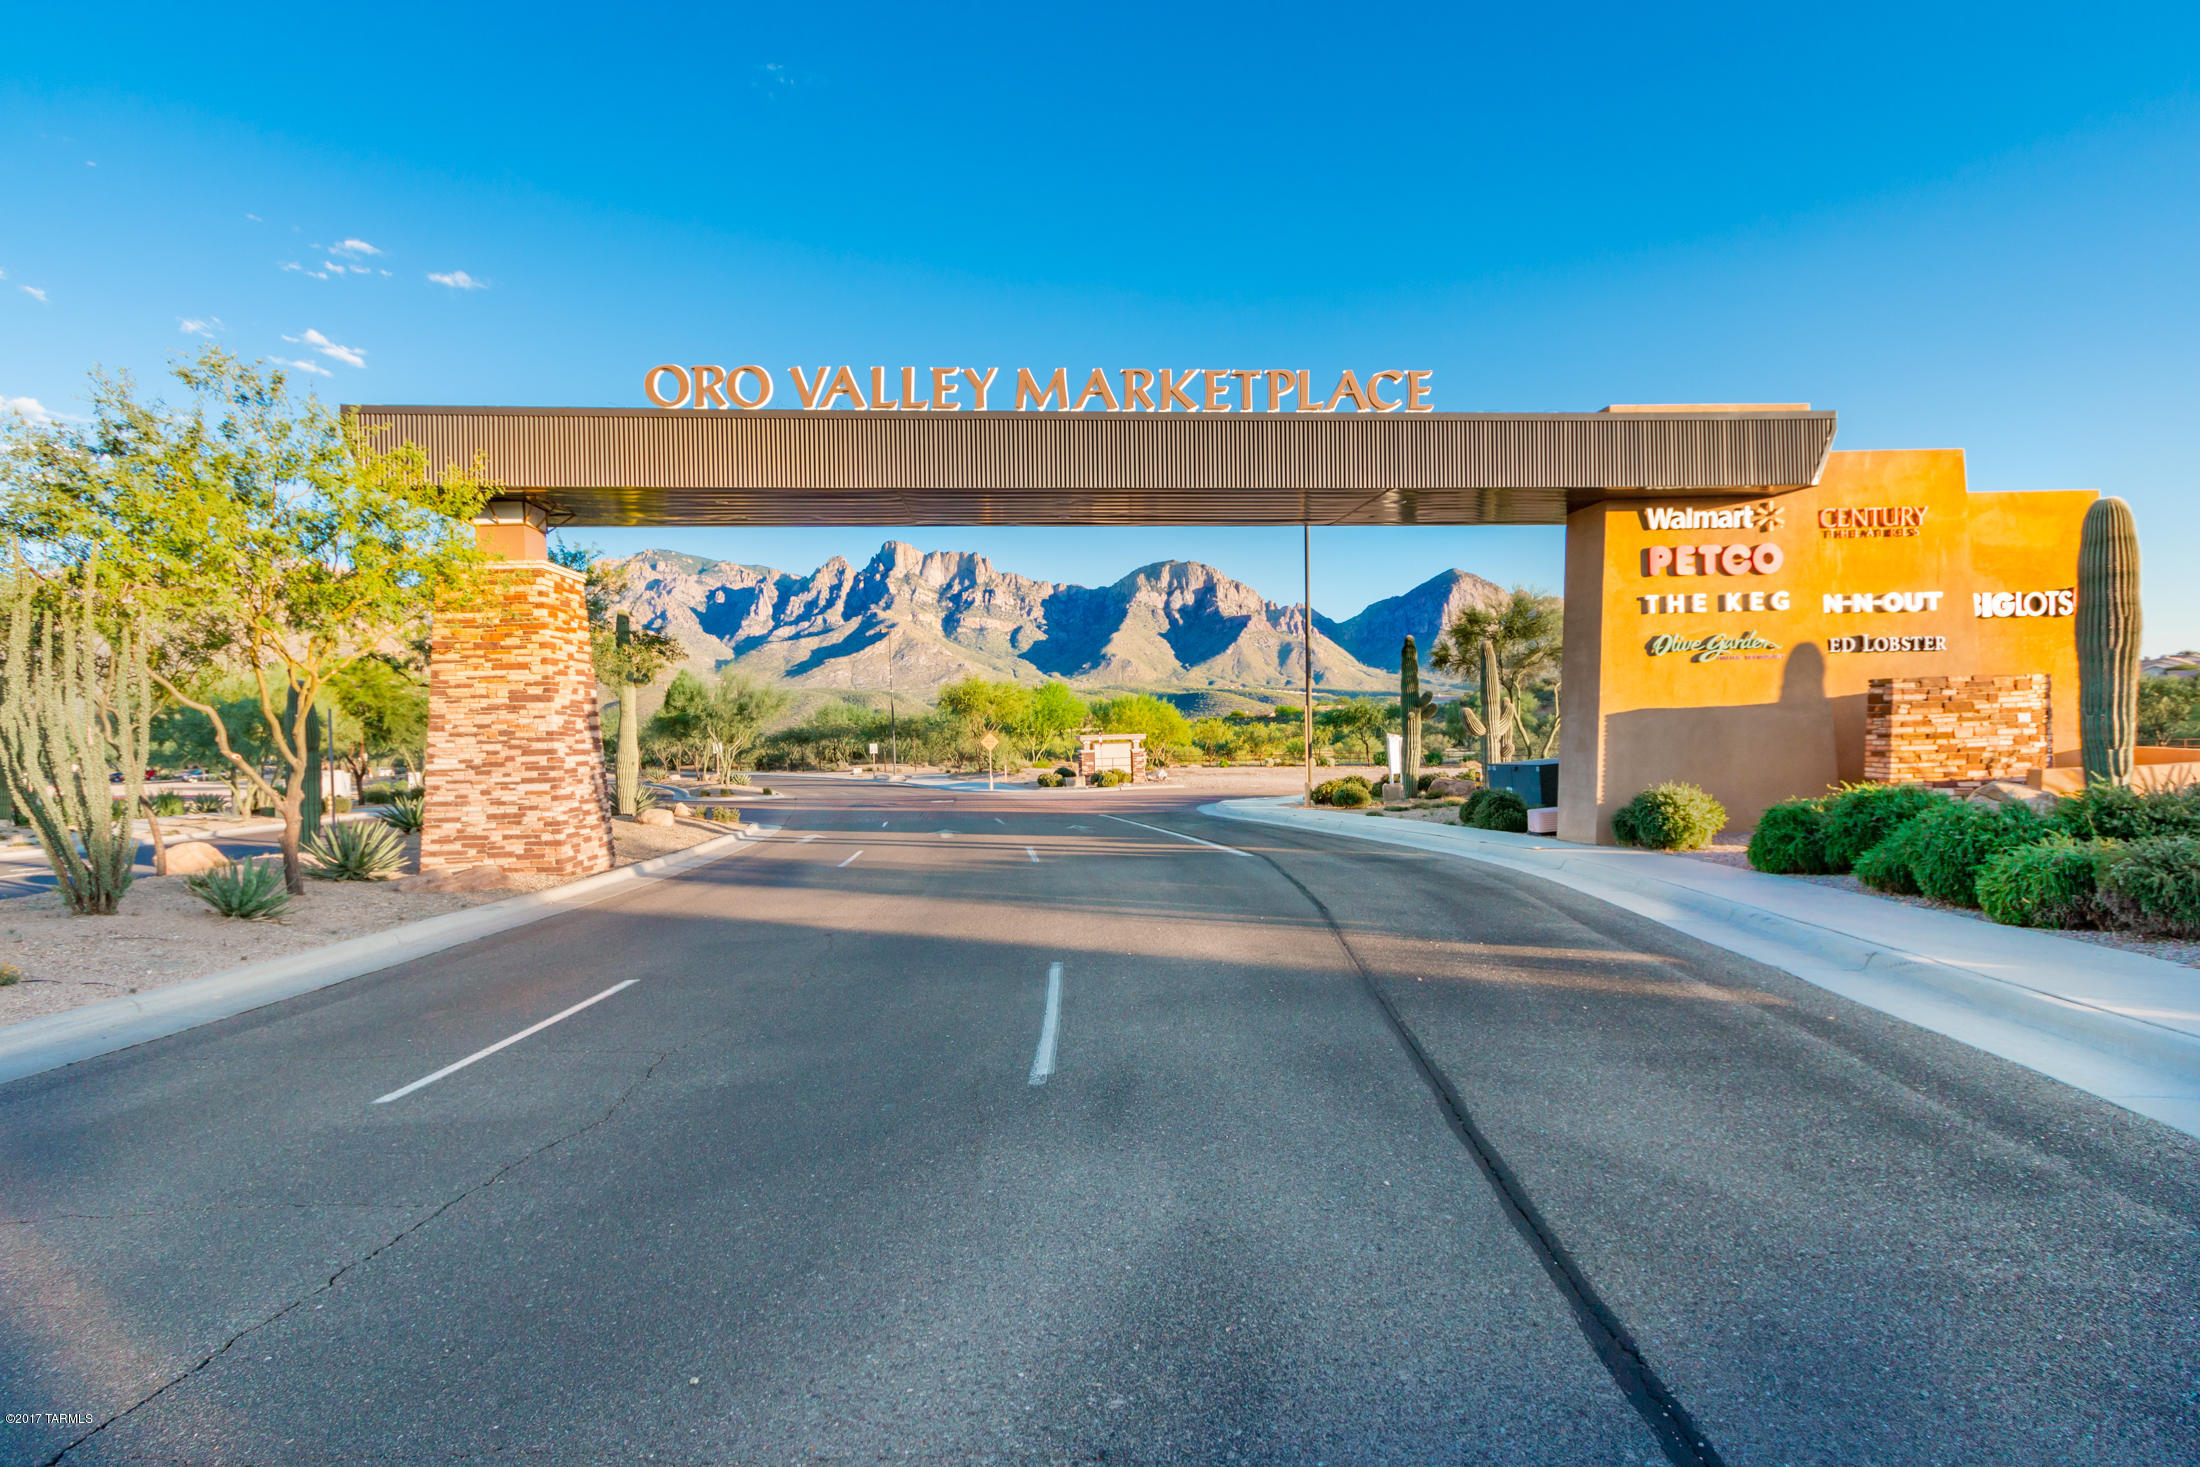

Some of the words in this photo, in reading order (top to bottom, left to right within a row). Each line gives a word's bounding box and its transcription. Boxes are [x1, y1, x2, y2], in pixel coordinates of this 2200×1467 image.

[644, 364, 774, 410] ORO
[788, 365, 999, 411] VALLEY
[1015, 367, 1434, 413] MARKETPLACE
[1646, 505, 1754, 530] Walmart
[1819, 506, 1928, 528] CENTURY
[1648, 542, 1784, 577] PETCO
[1644, 593, 1708, 614] THE
[1725, 591, 1790, 612] KEG
[1652, 633, 1705, 656] Olive
[1699, 630, 1783, 662] Garden
[1862, 634, 1947, 652] LOBSTER
